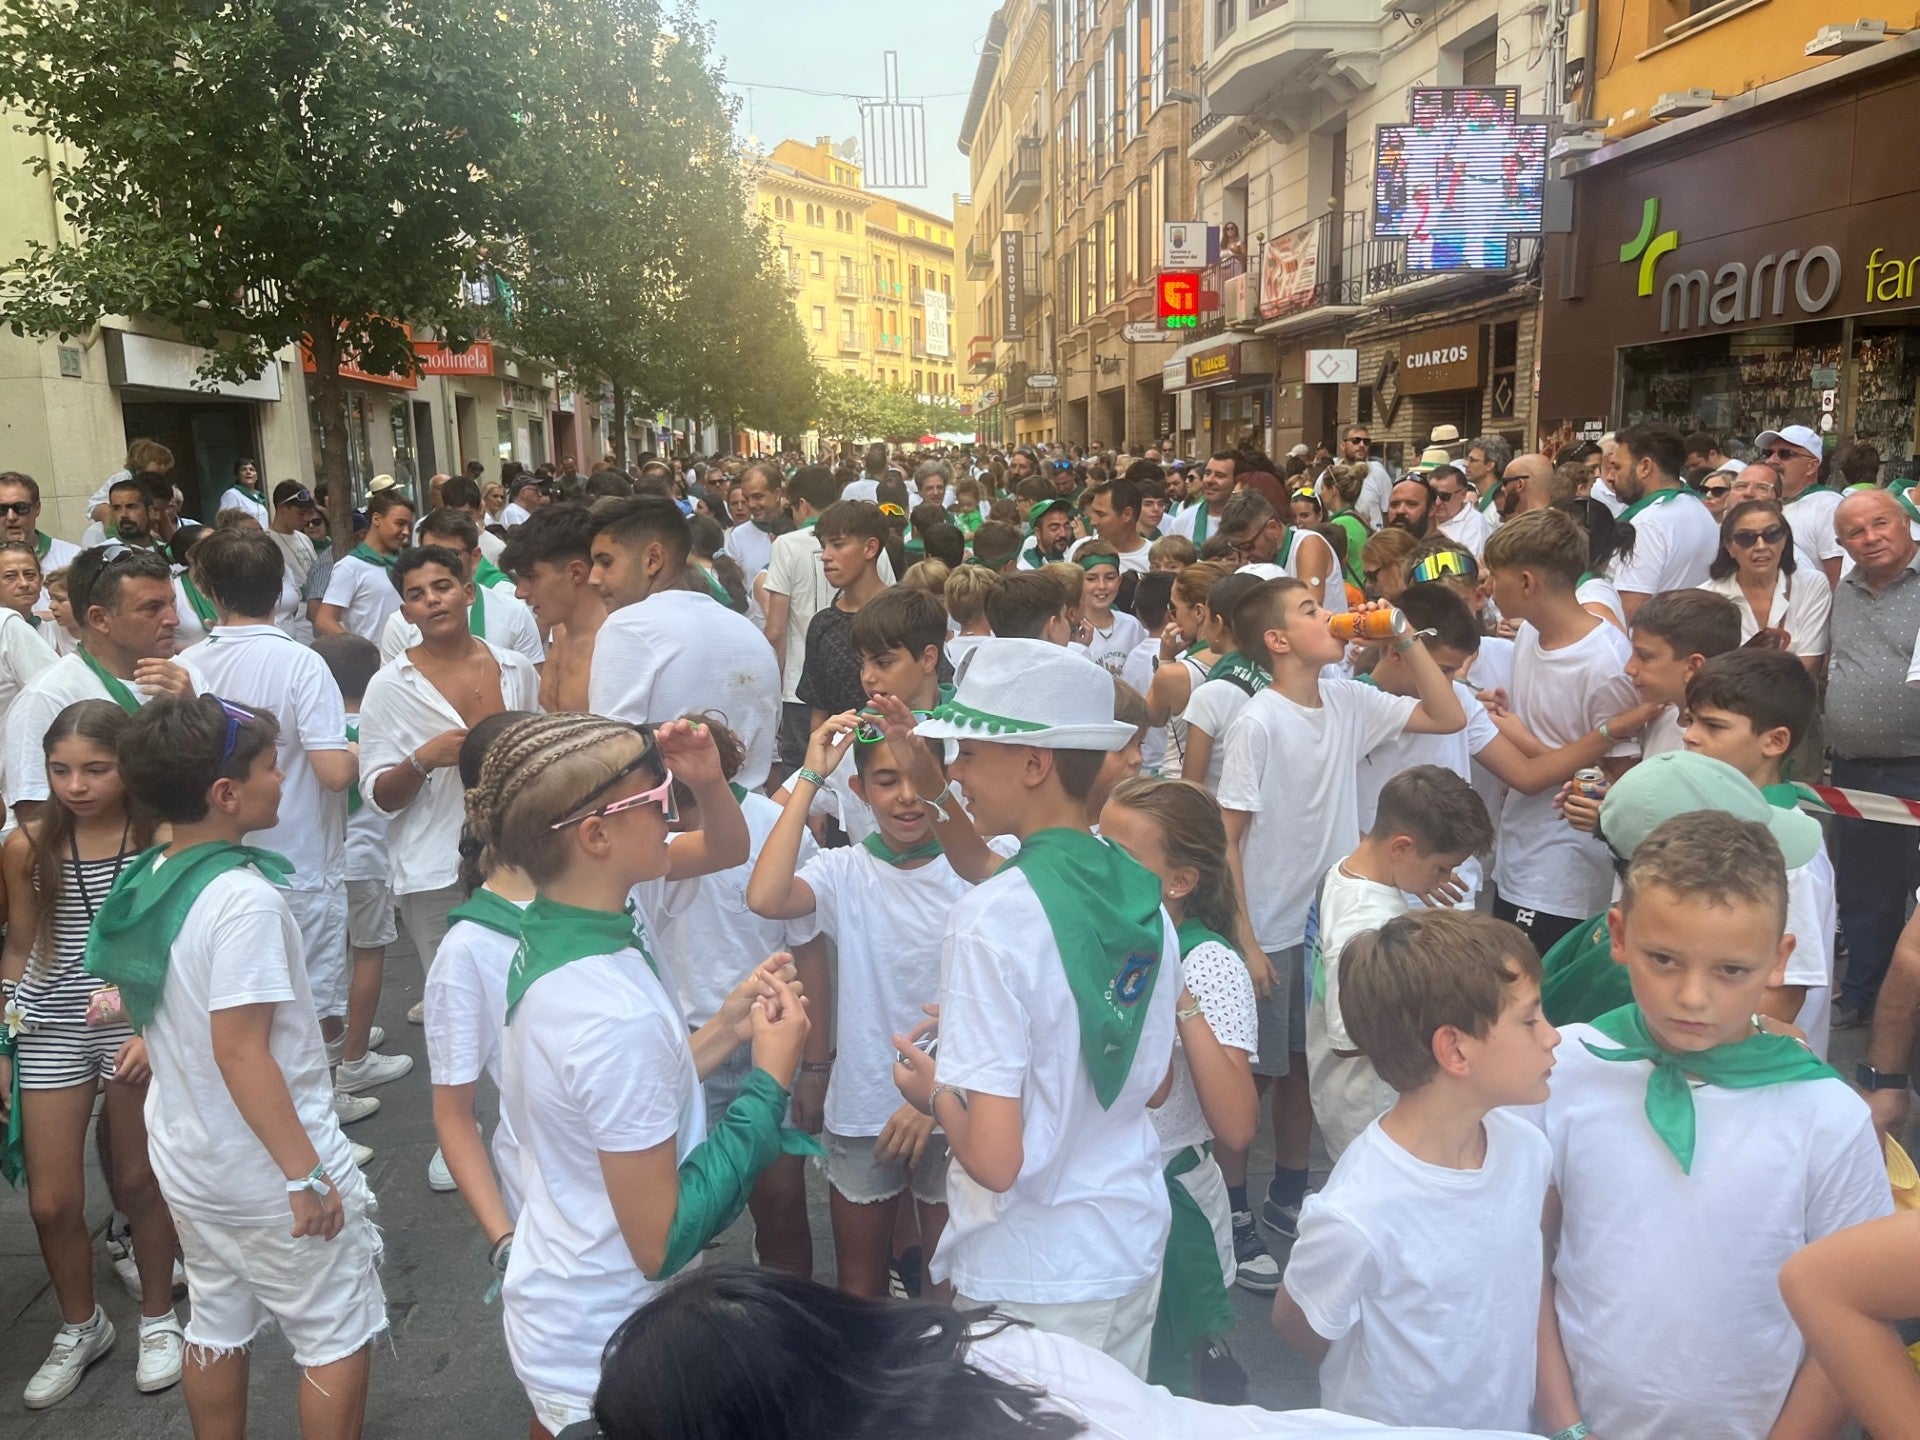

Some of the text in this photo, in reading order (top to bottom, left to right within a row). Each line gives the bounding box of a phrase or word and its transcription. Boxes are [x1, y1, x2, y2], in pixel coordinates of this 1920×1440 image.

[1005, 233, 1017, 331] Montovelaz
[1660, 245, 1842, 332] marro
[1200, 354, 1226, 372] TABACOS
[1406, 345, 1468, 370] CUARZOS
[1515, 908, 1536, 927] R
